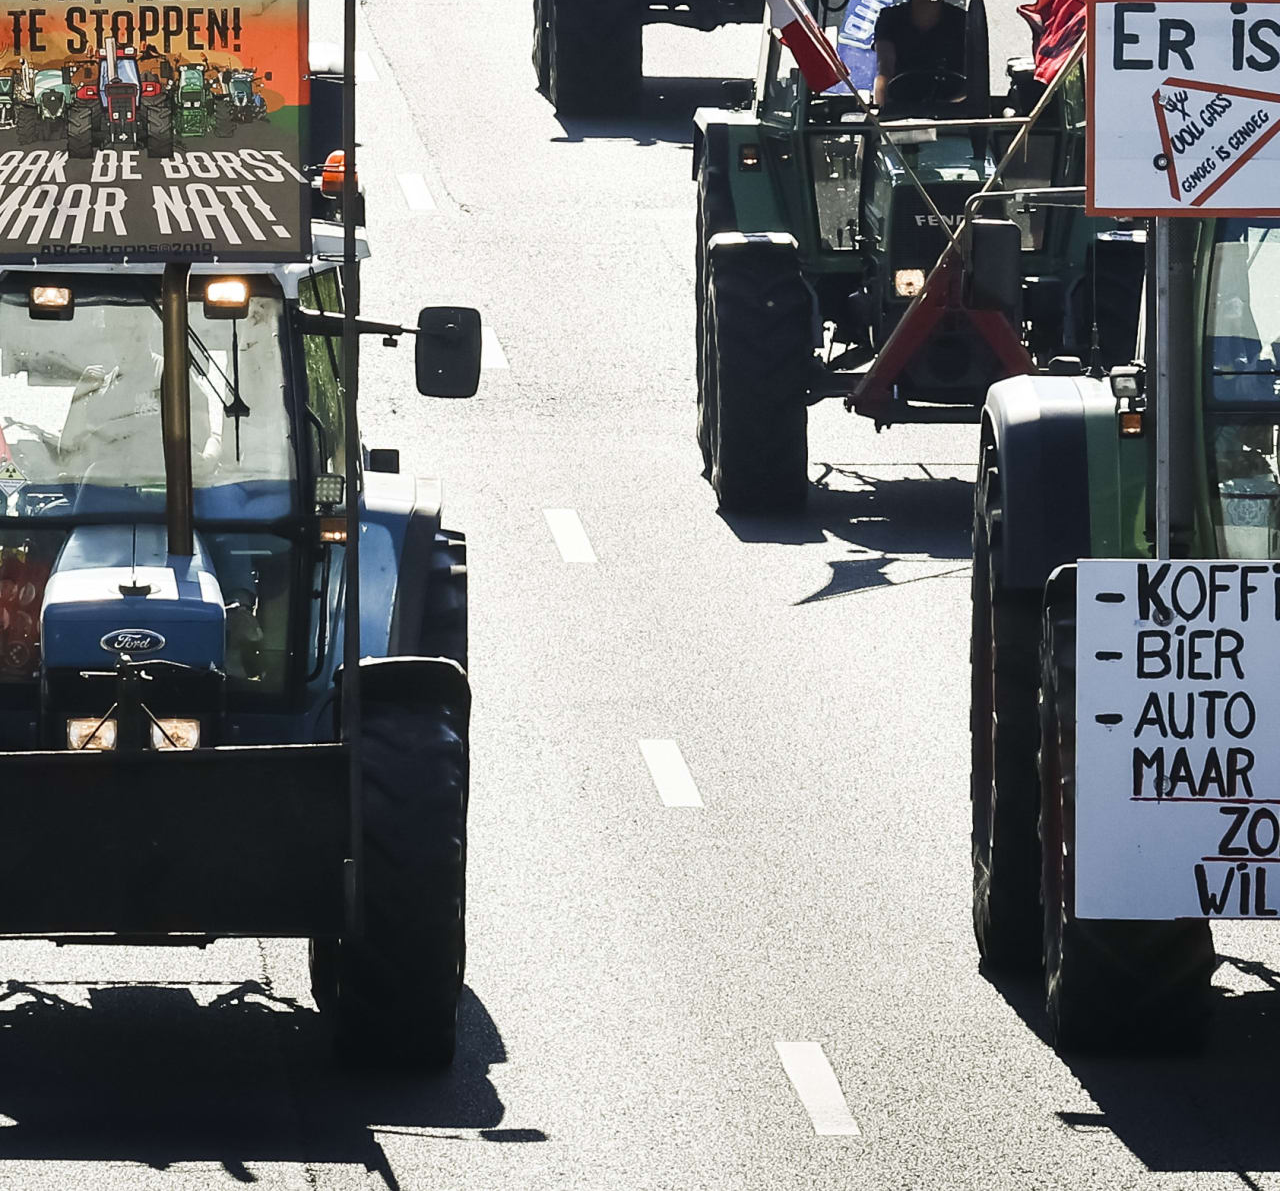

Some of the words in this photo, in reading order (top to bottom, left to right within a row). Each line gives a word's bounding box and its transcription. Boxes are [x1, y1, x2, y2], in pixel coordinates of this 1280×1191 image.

[8, 9, 46, 56] TE
[65, 6, 242, 55] STOPPEN!
[1200, 93, 1232, 128] GASS
[90, 150, 143, 183] DE
[160, 149, 309, 184] BORST
[1181, 157, 1216, 193] GENOEG
[1228, 109, 1269, 150] GENOEG
[152, 183, 292, 244] NAT!
[114, 633, 151, 648] Ford
[1134, 691, 1256, 739] AUTO
[1132, 747, 1255, 798] MAAR
